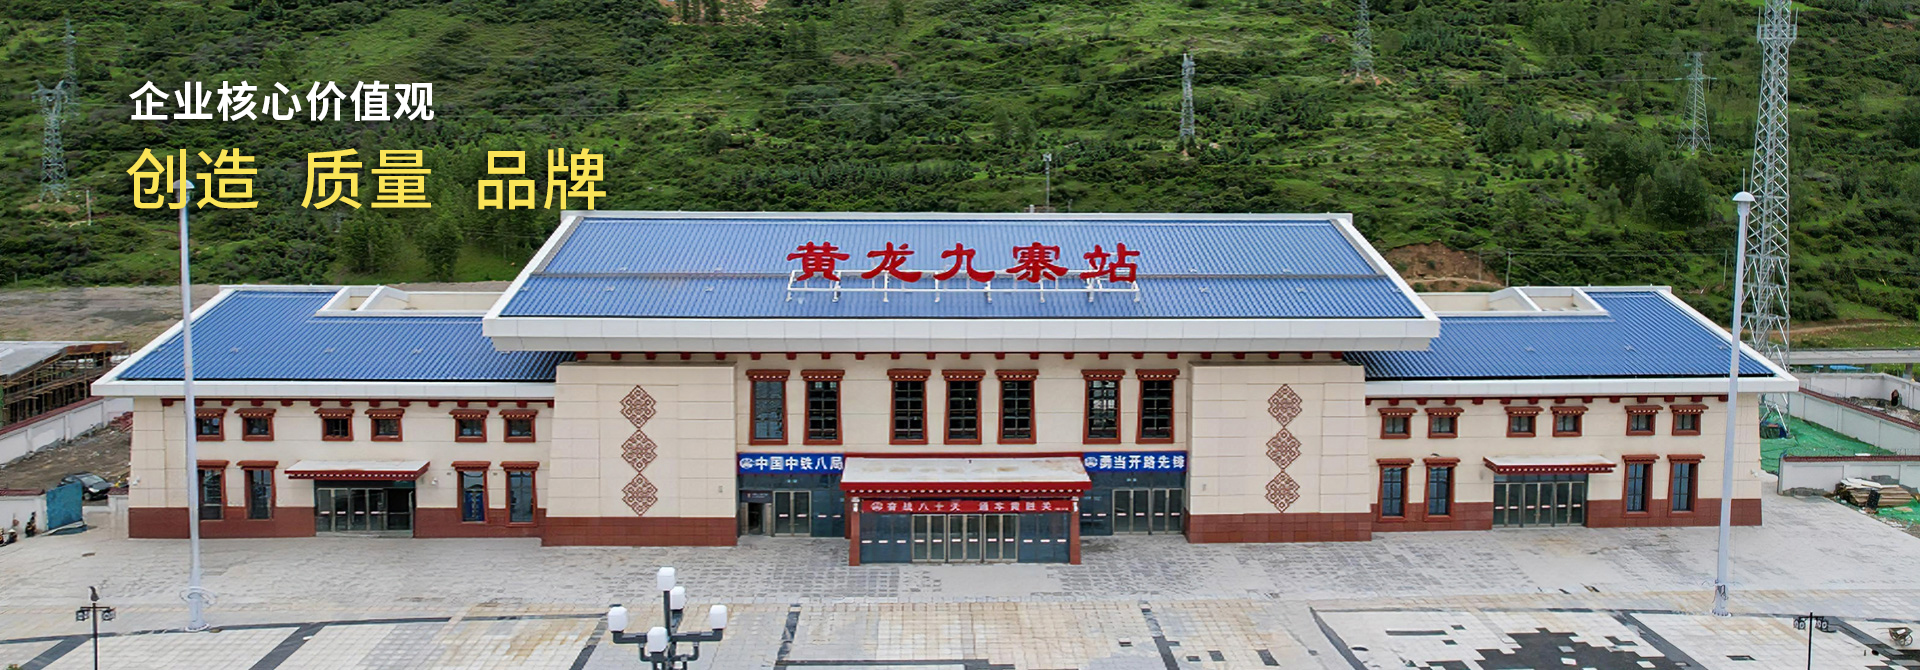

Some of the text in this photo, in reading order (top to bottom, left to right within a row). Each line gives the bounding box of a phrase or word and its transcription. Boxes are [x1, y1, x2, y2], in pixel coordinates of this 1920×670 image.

[787, 241, 1141, 284] 黄龙九寨站
[755, 456, 844, 471] 中国中铁八局
[1099, 455, 1185, 469] 勇当开路先锋
